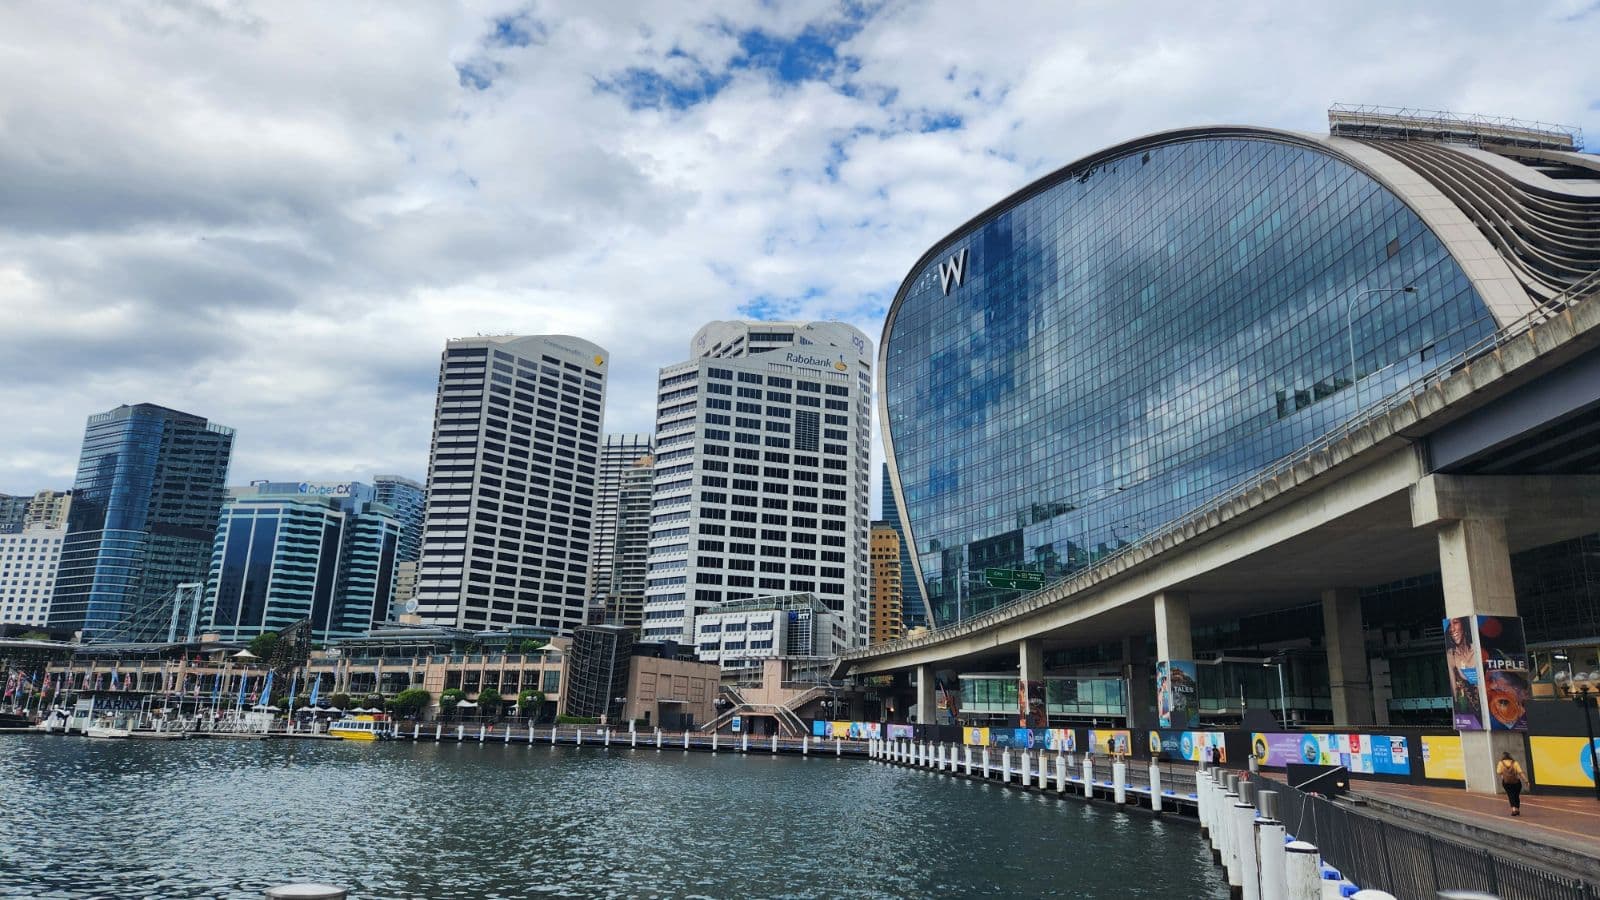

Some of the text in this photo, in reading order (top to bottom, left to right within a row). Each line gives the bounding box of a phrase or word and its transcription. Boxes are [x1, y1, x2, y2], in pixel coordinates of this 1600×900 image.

[938, 247, 968, 297] W
[786, 352, 832, 368] Rabobank
[308, 484, 352, 495] CyberCX
[1487, 659, 1525, 670] TIPPLE
[1173, 685, 1194, 693] TALES
[93, 700, 143, 710] MARINA
